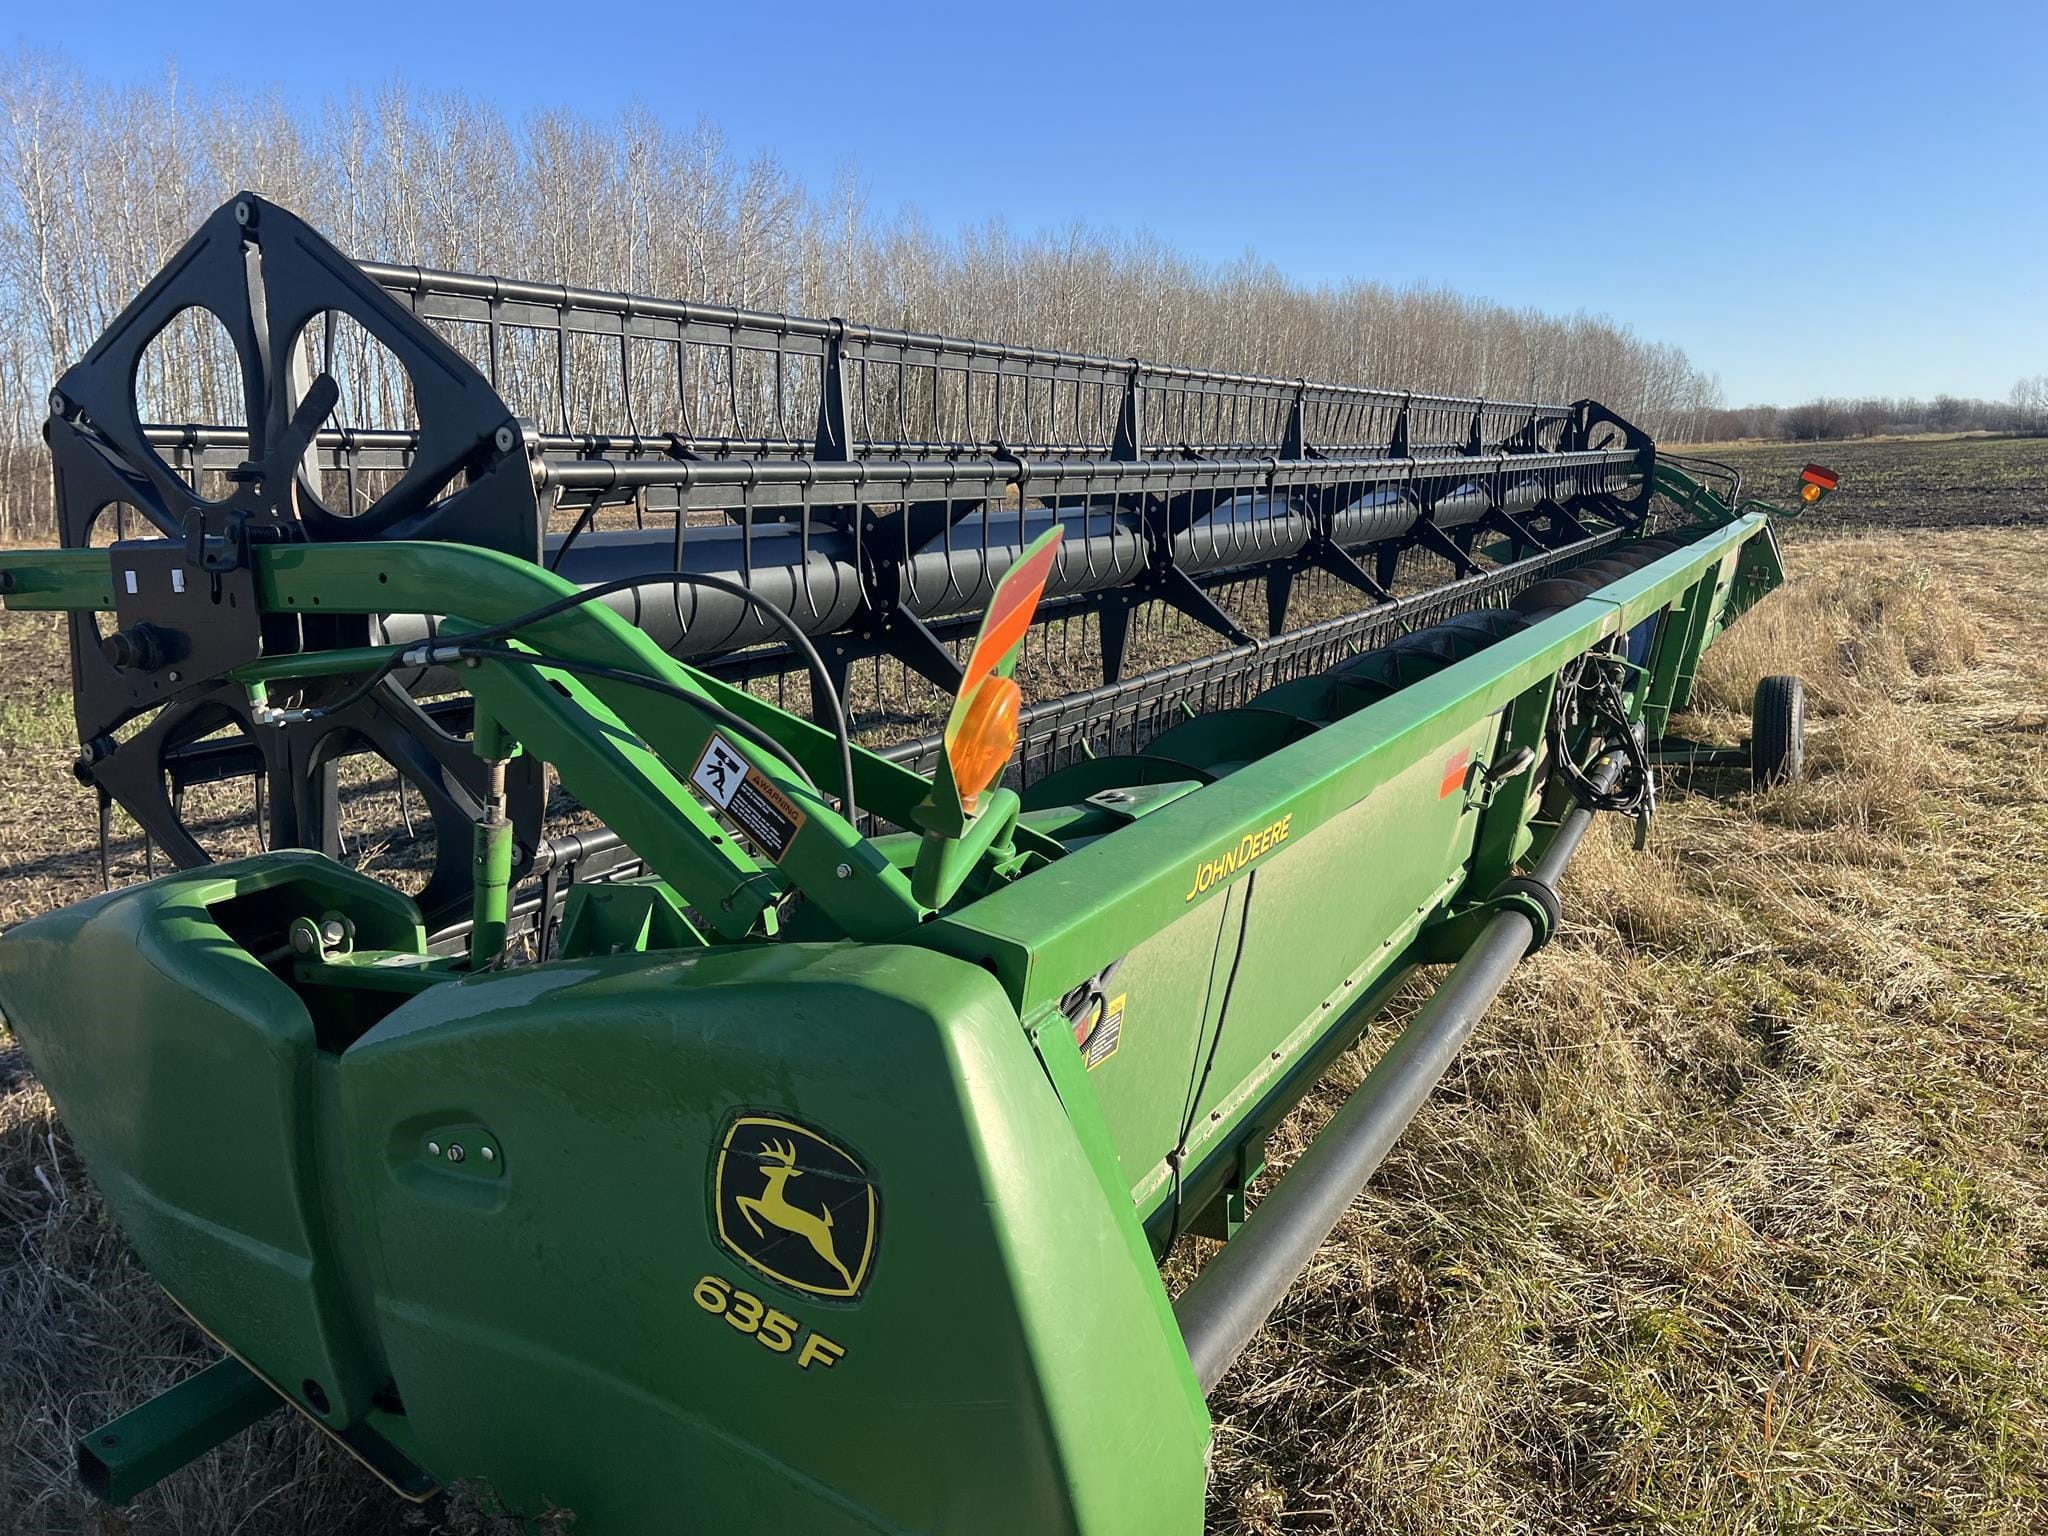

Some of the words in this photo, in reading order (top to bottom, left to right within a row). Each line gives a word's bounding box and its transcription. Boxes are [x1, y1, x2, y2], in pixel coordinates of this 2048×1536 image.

[760, 780, 799, 821] WARNING
[1186, 846, 1239, 903] JOHN
[1237, 812, 1293, 869] DEERE
